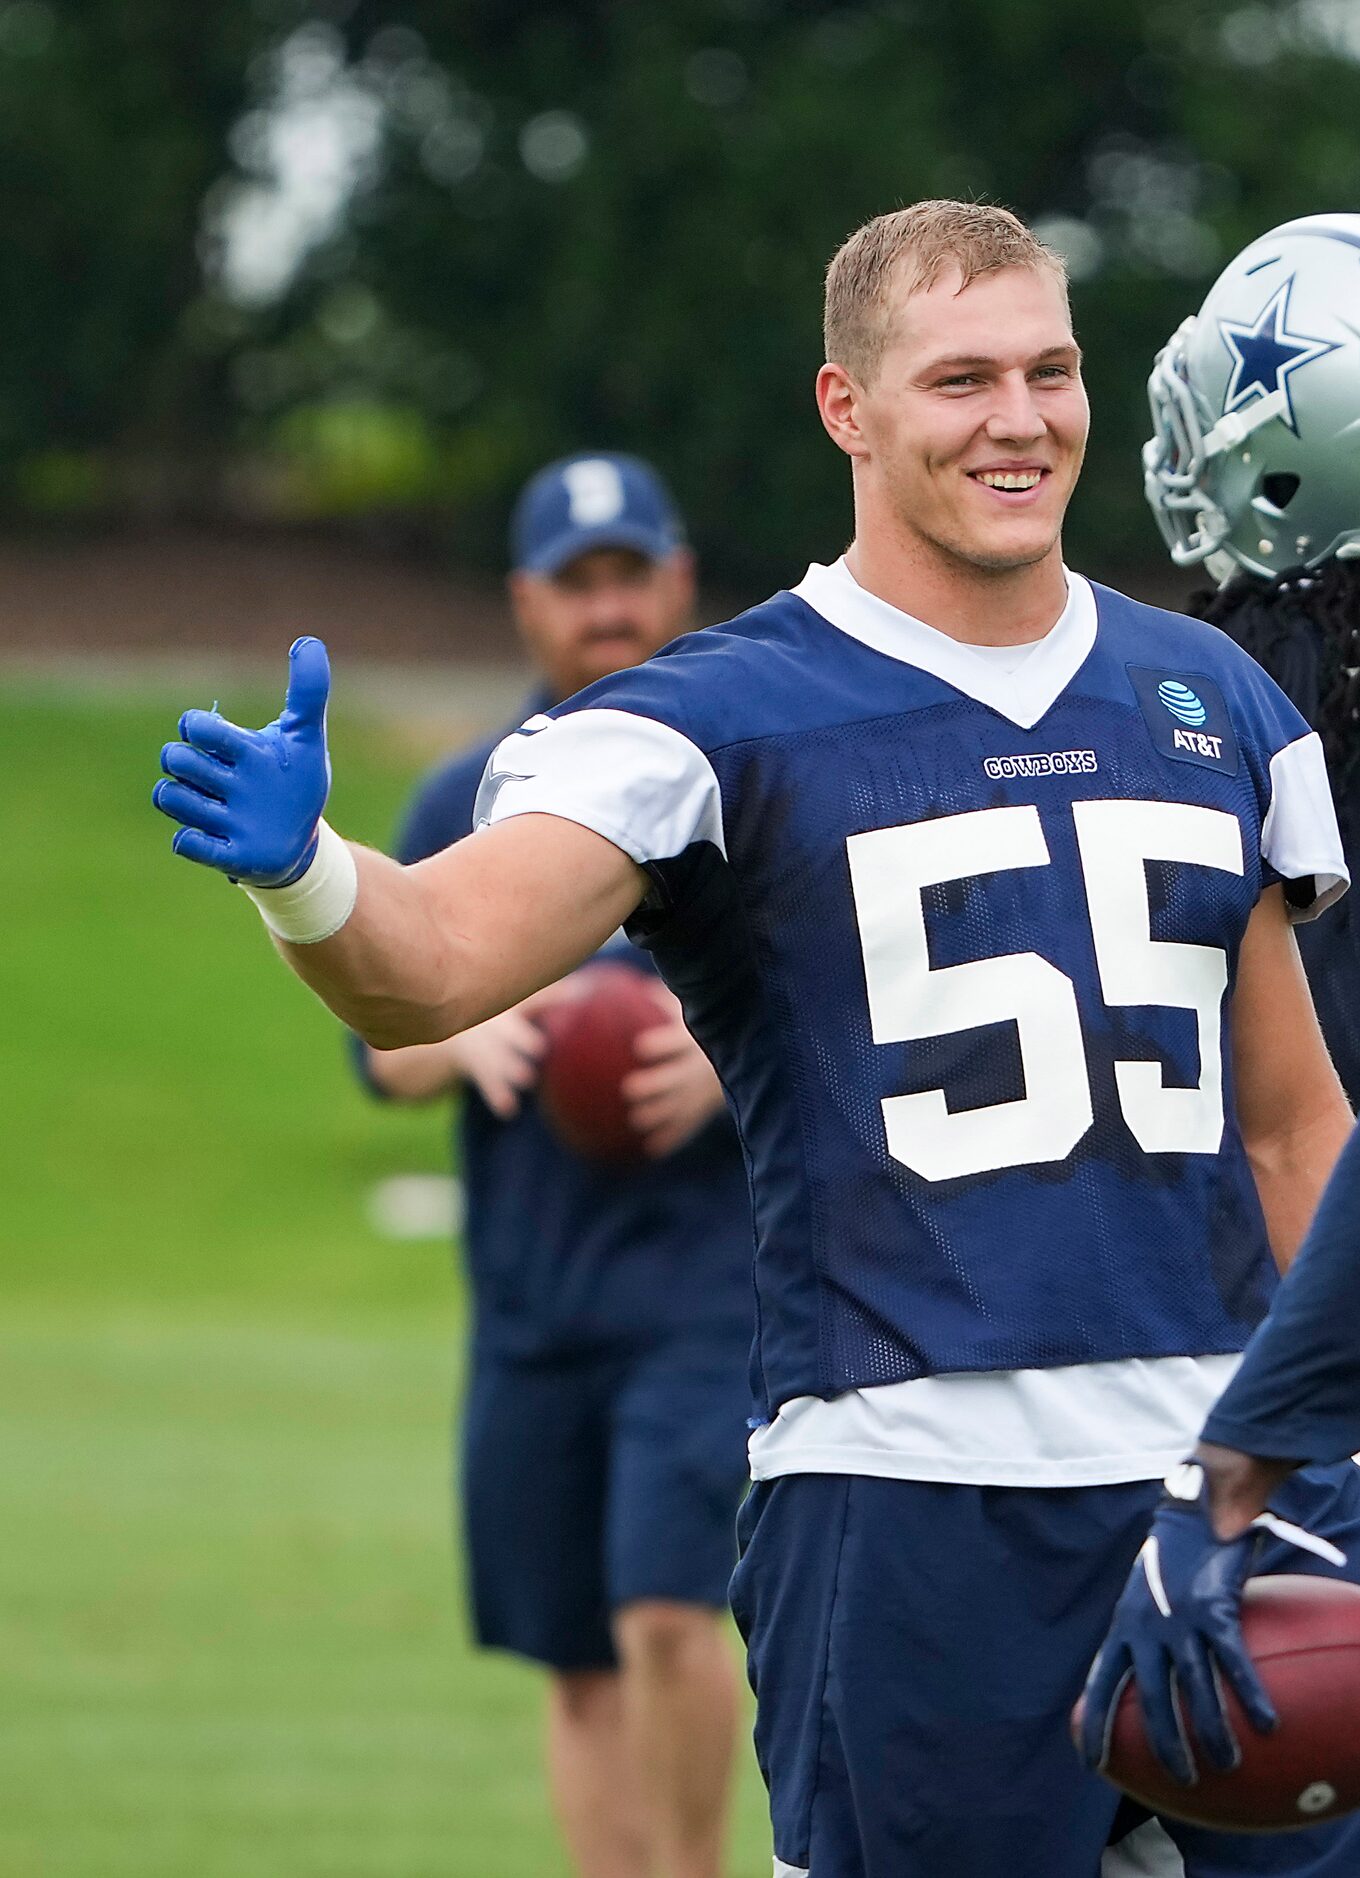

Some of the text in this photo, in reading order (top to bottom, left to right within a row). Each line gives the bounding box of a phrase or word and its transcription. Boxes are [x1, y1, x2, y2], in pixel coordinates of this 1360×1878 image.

[1173, 728, 1223, 759] AT&T
[983, 750, 1098, 780] COWBOYS
[845, 798, 1245, 1183] 55
